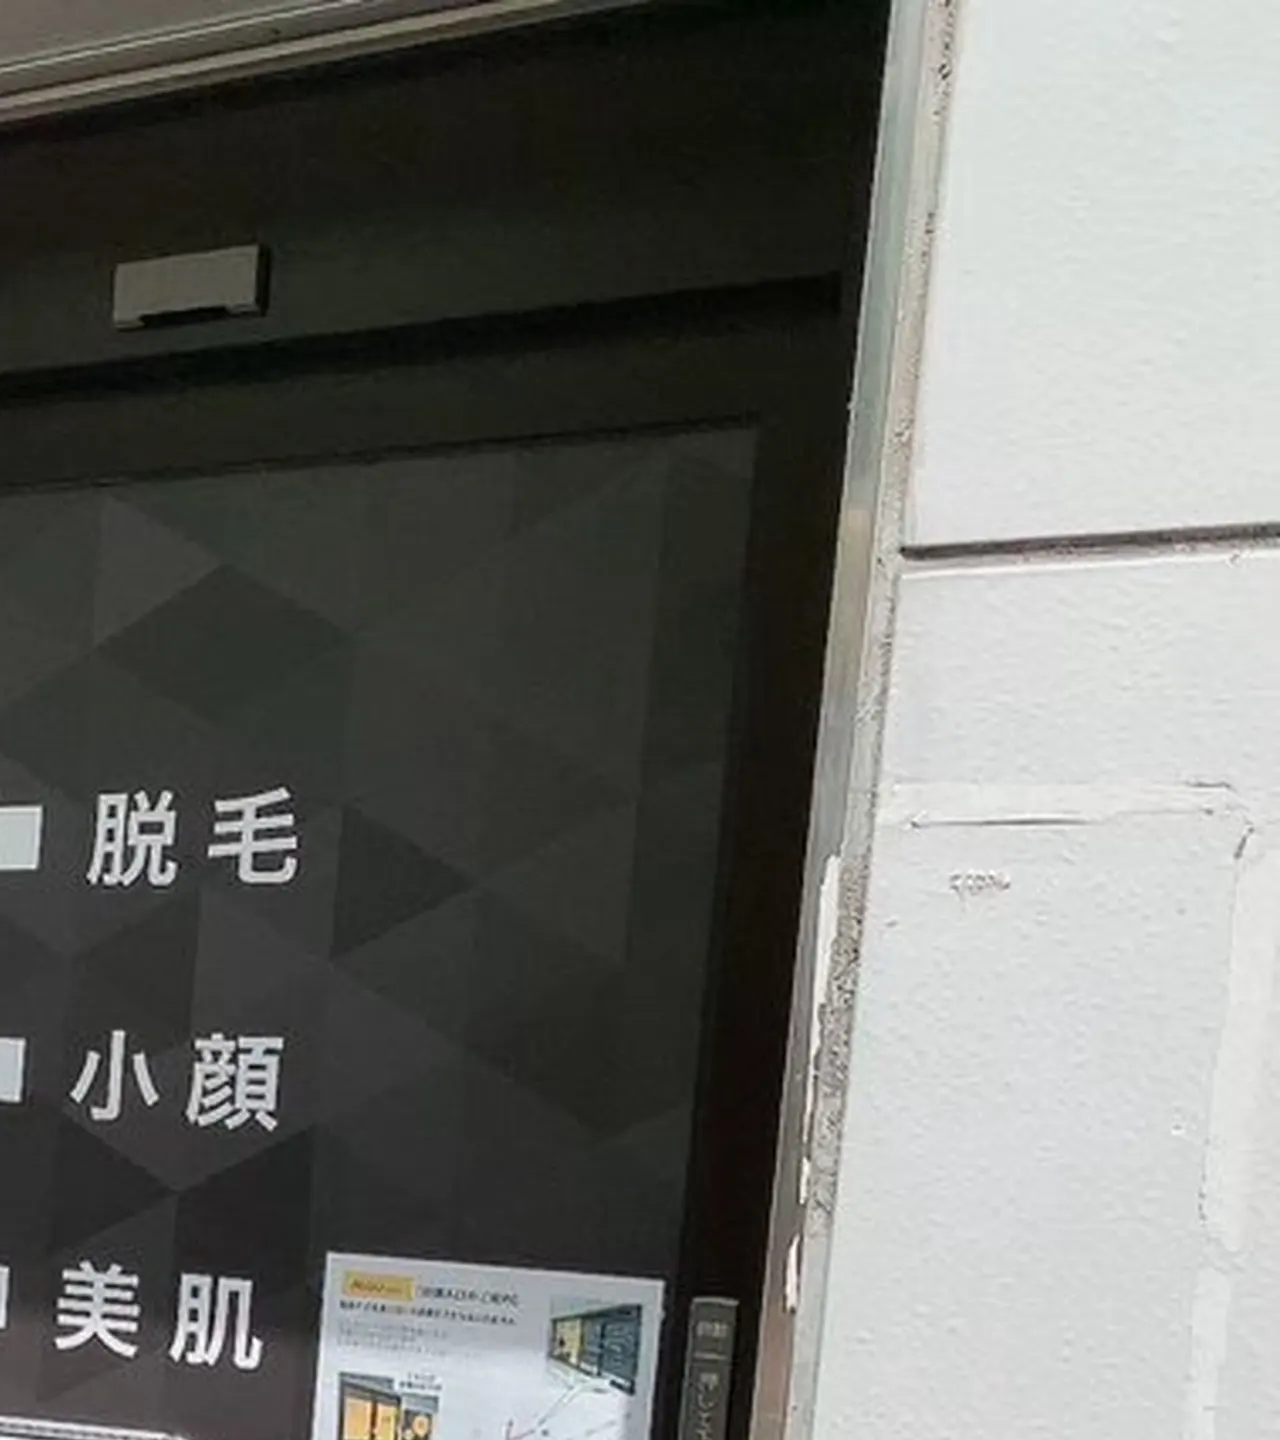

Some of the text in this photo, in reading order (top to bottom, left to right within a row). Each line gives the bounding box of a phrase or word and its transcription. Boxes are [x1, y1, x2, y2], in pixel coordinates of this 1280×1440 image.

[85, 786, 300, 888] 脱毛
[69, 1028, 286, 1133] 小顔
[53, 1260, 265, 1371] 美肌
